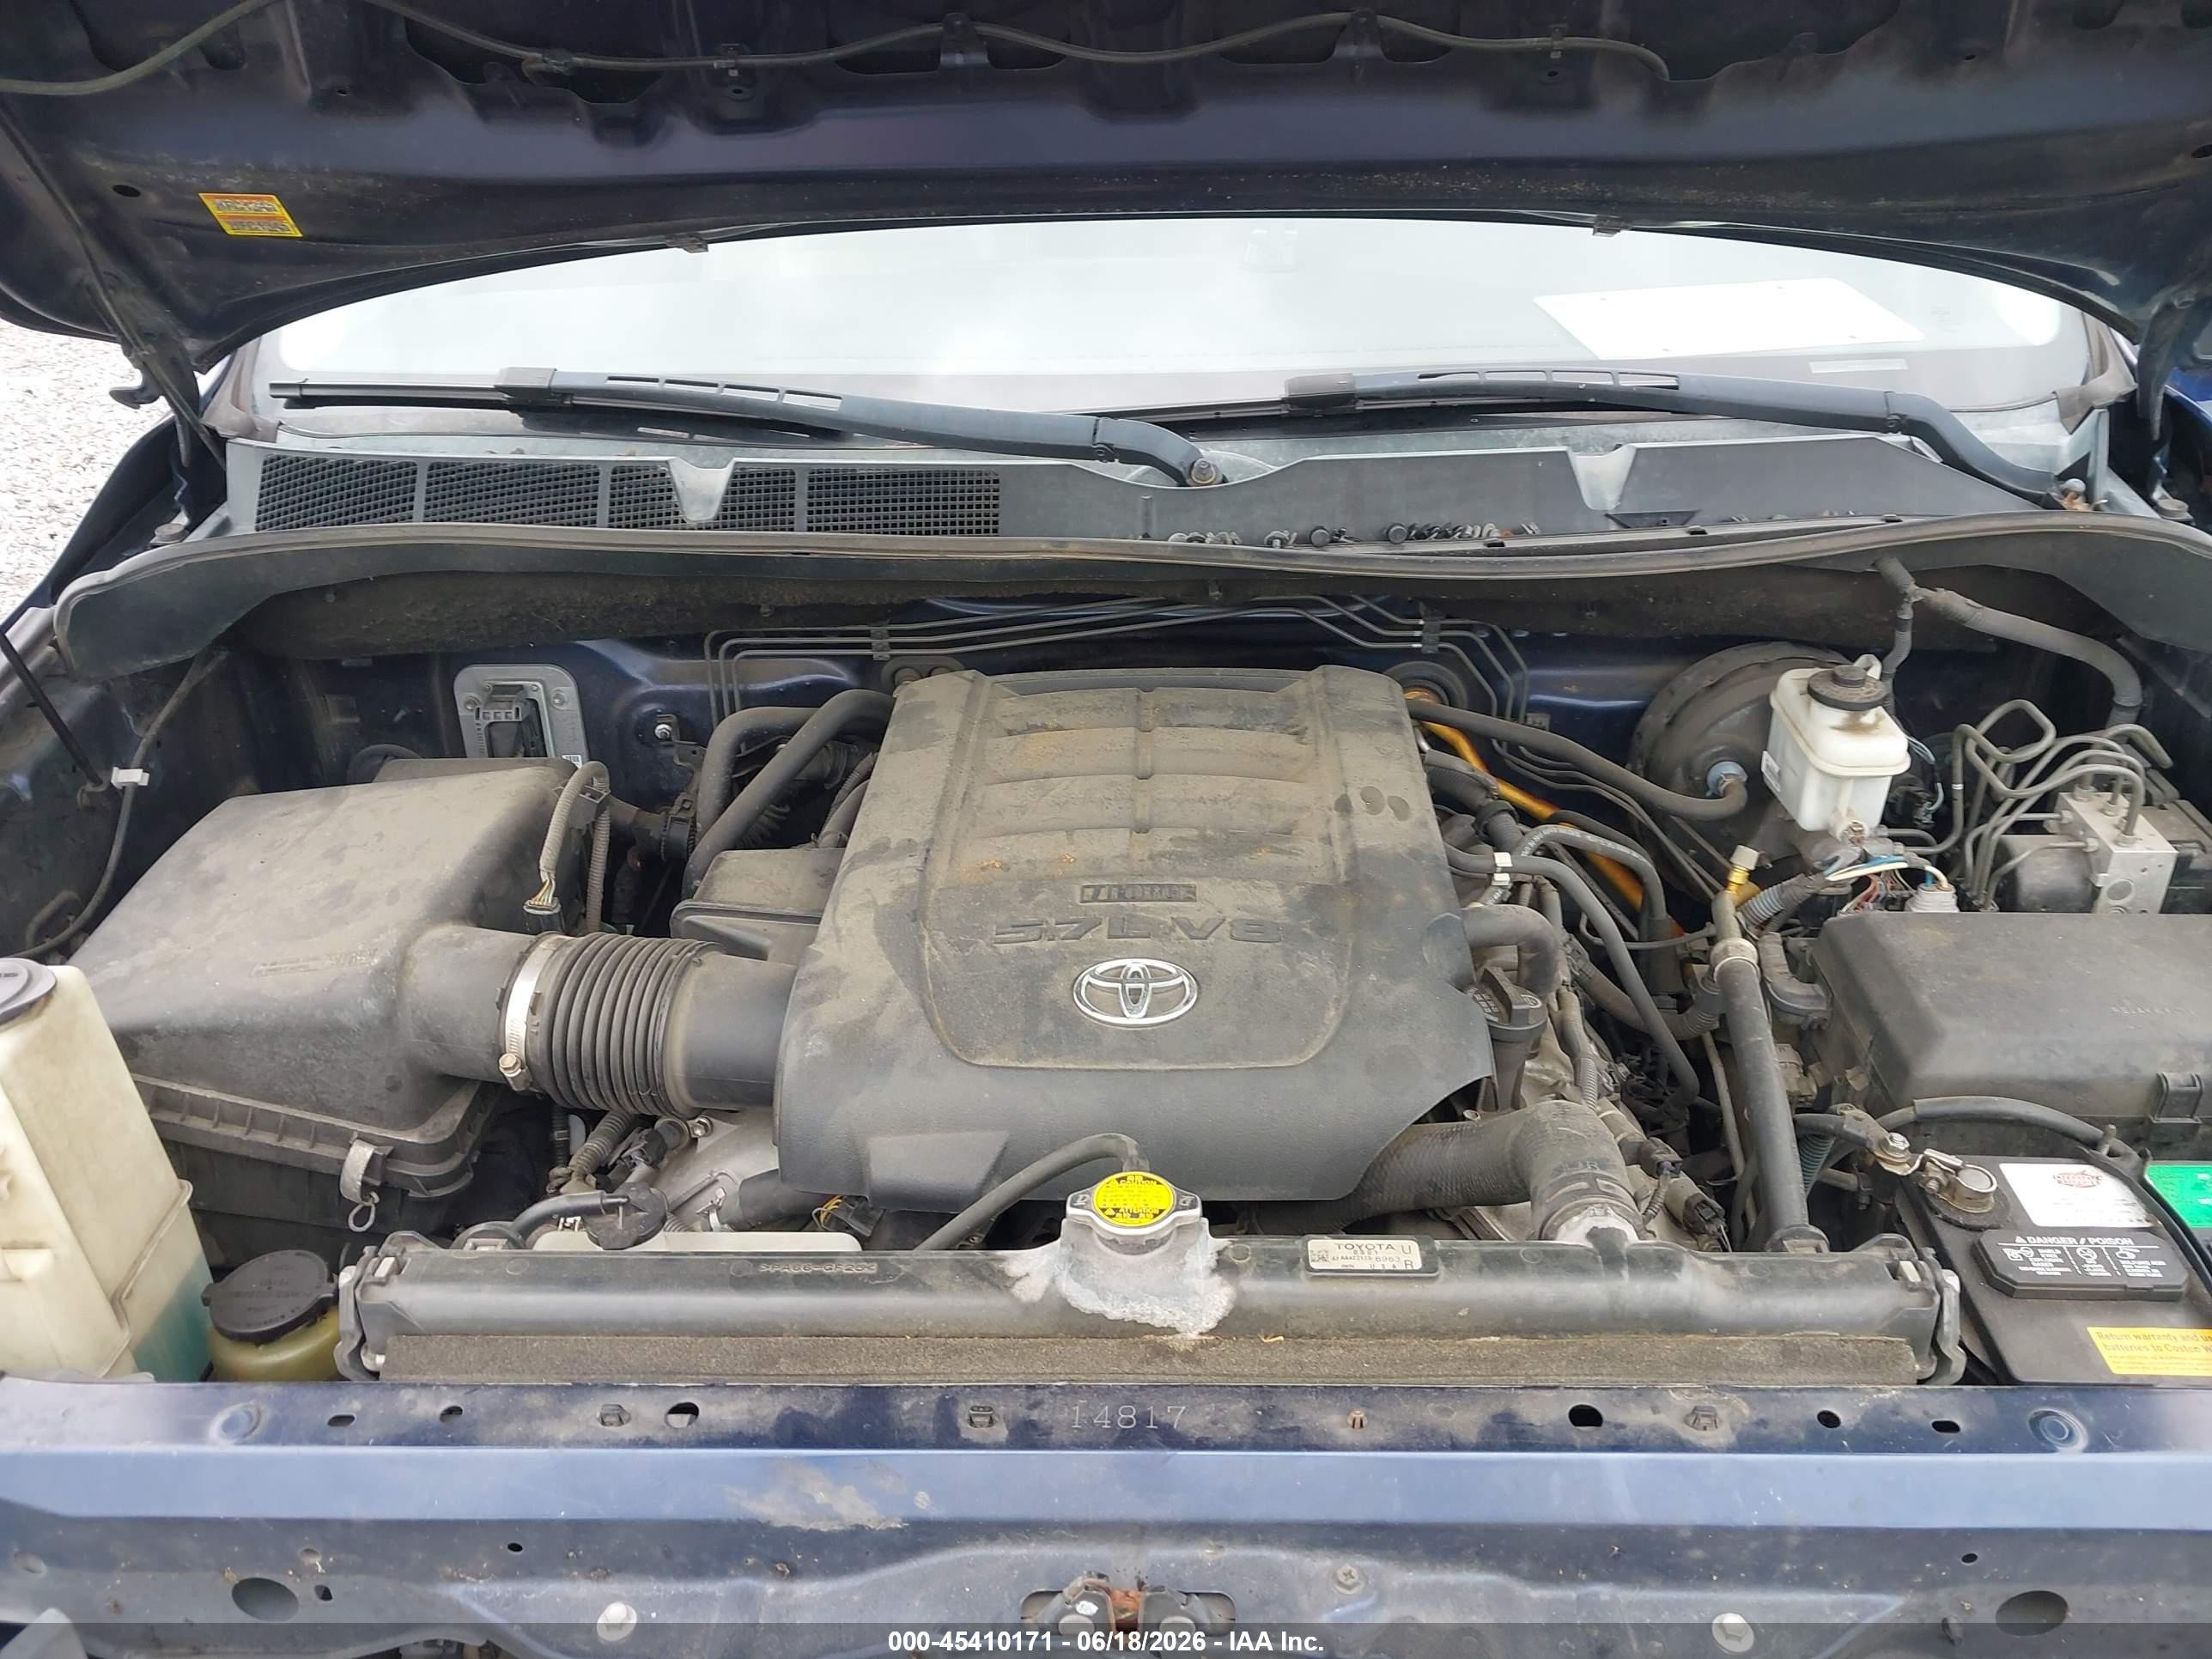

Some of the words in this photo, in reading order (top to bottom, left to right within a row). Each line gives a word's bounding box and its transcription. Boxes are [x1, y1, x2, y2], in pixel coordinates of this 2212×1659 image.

[1171, 917, 1282, 943] V8
[2027, 1237, 2077, 1245] DANGER
[1401, 1245, 1412, 1255] U
[1404, 1260, 1414, 1269] R
[2102, 1343, 2149, 1352] batteries
[2164, 1343, 2201, 1352] Costco
[1072, 1406, 1186, 1429] 14817
